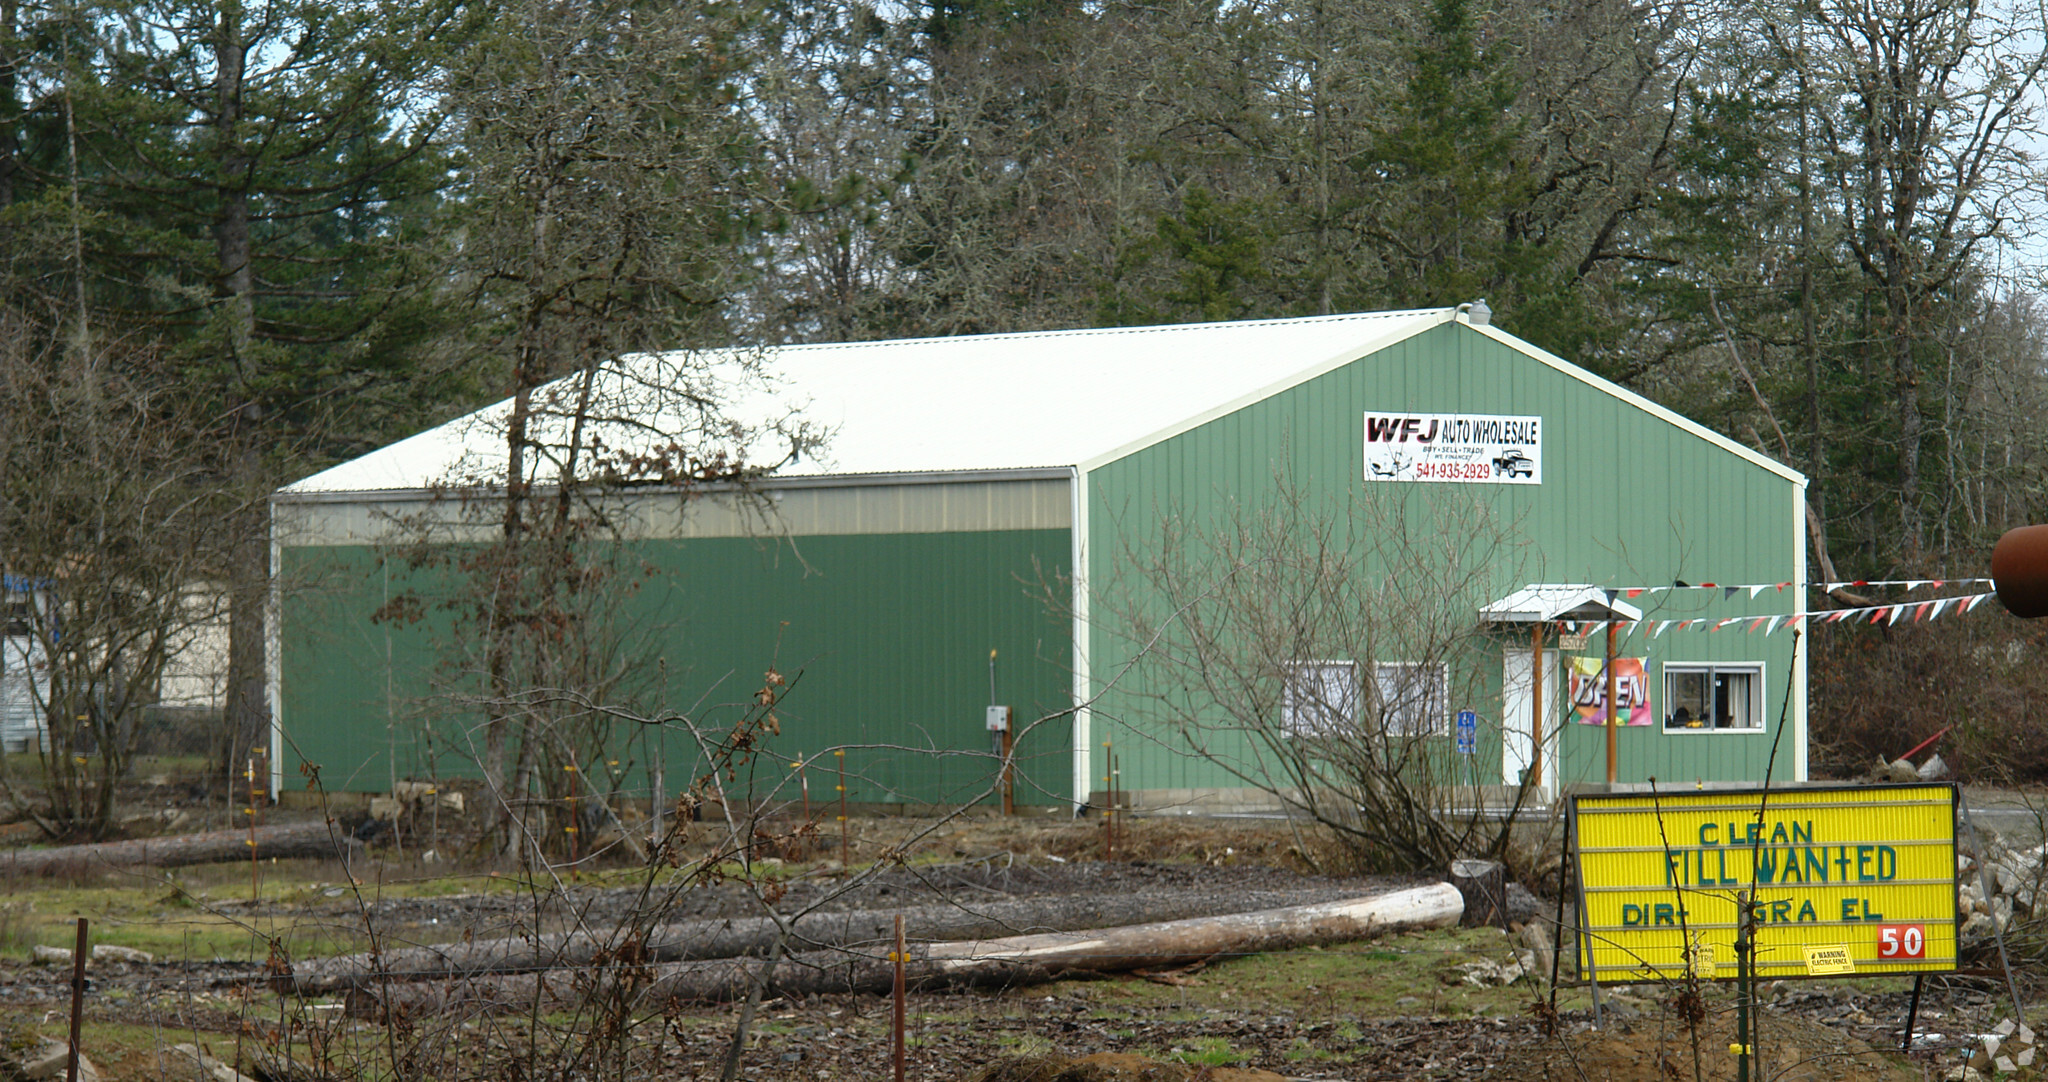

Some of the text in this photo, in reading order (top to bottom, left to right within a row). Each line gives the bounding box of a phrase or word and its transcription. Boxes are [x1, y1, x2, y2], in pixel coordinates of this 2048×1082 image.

[1368, 417, 1537, 445] WFJ AUTO WHOLESALE
[1416, 462, 1490, 479] 541-935-2929
[1699, 820, 1813, 845] CLEAN
[1665, 847, 1738, 887] FILL
[1817, 950, 1846, 958] WARNING
[1882, 927, 1922, 956] 50
